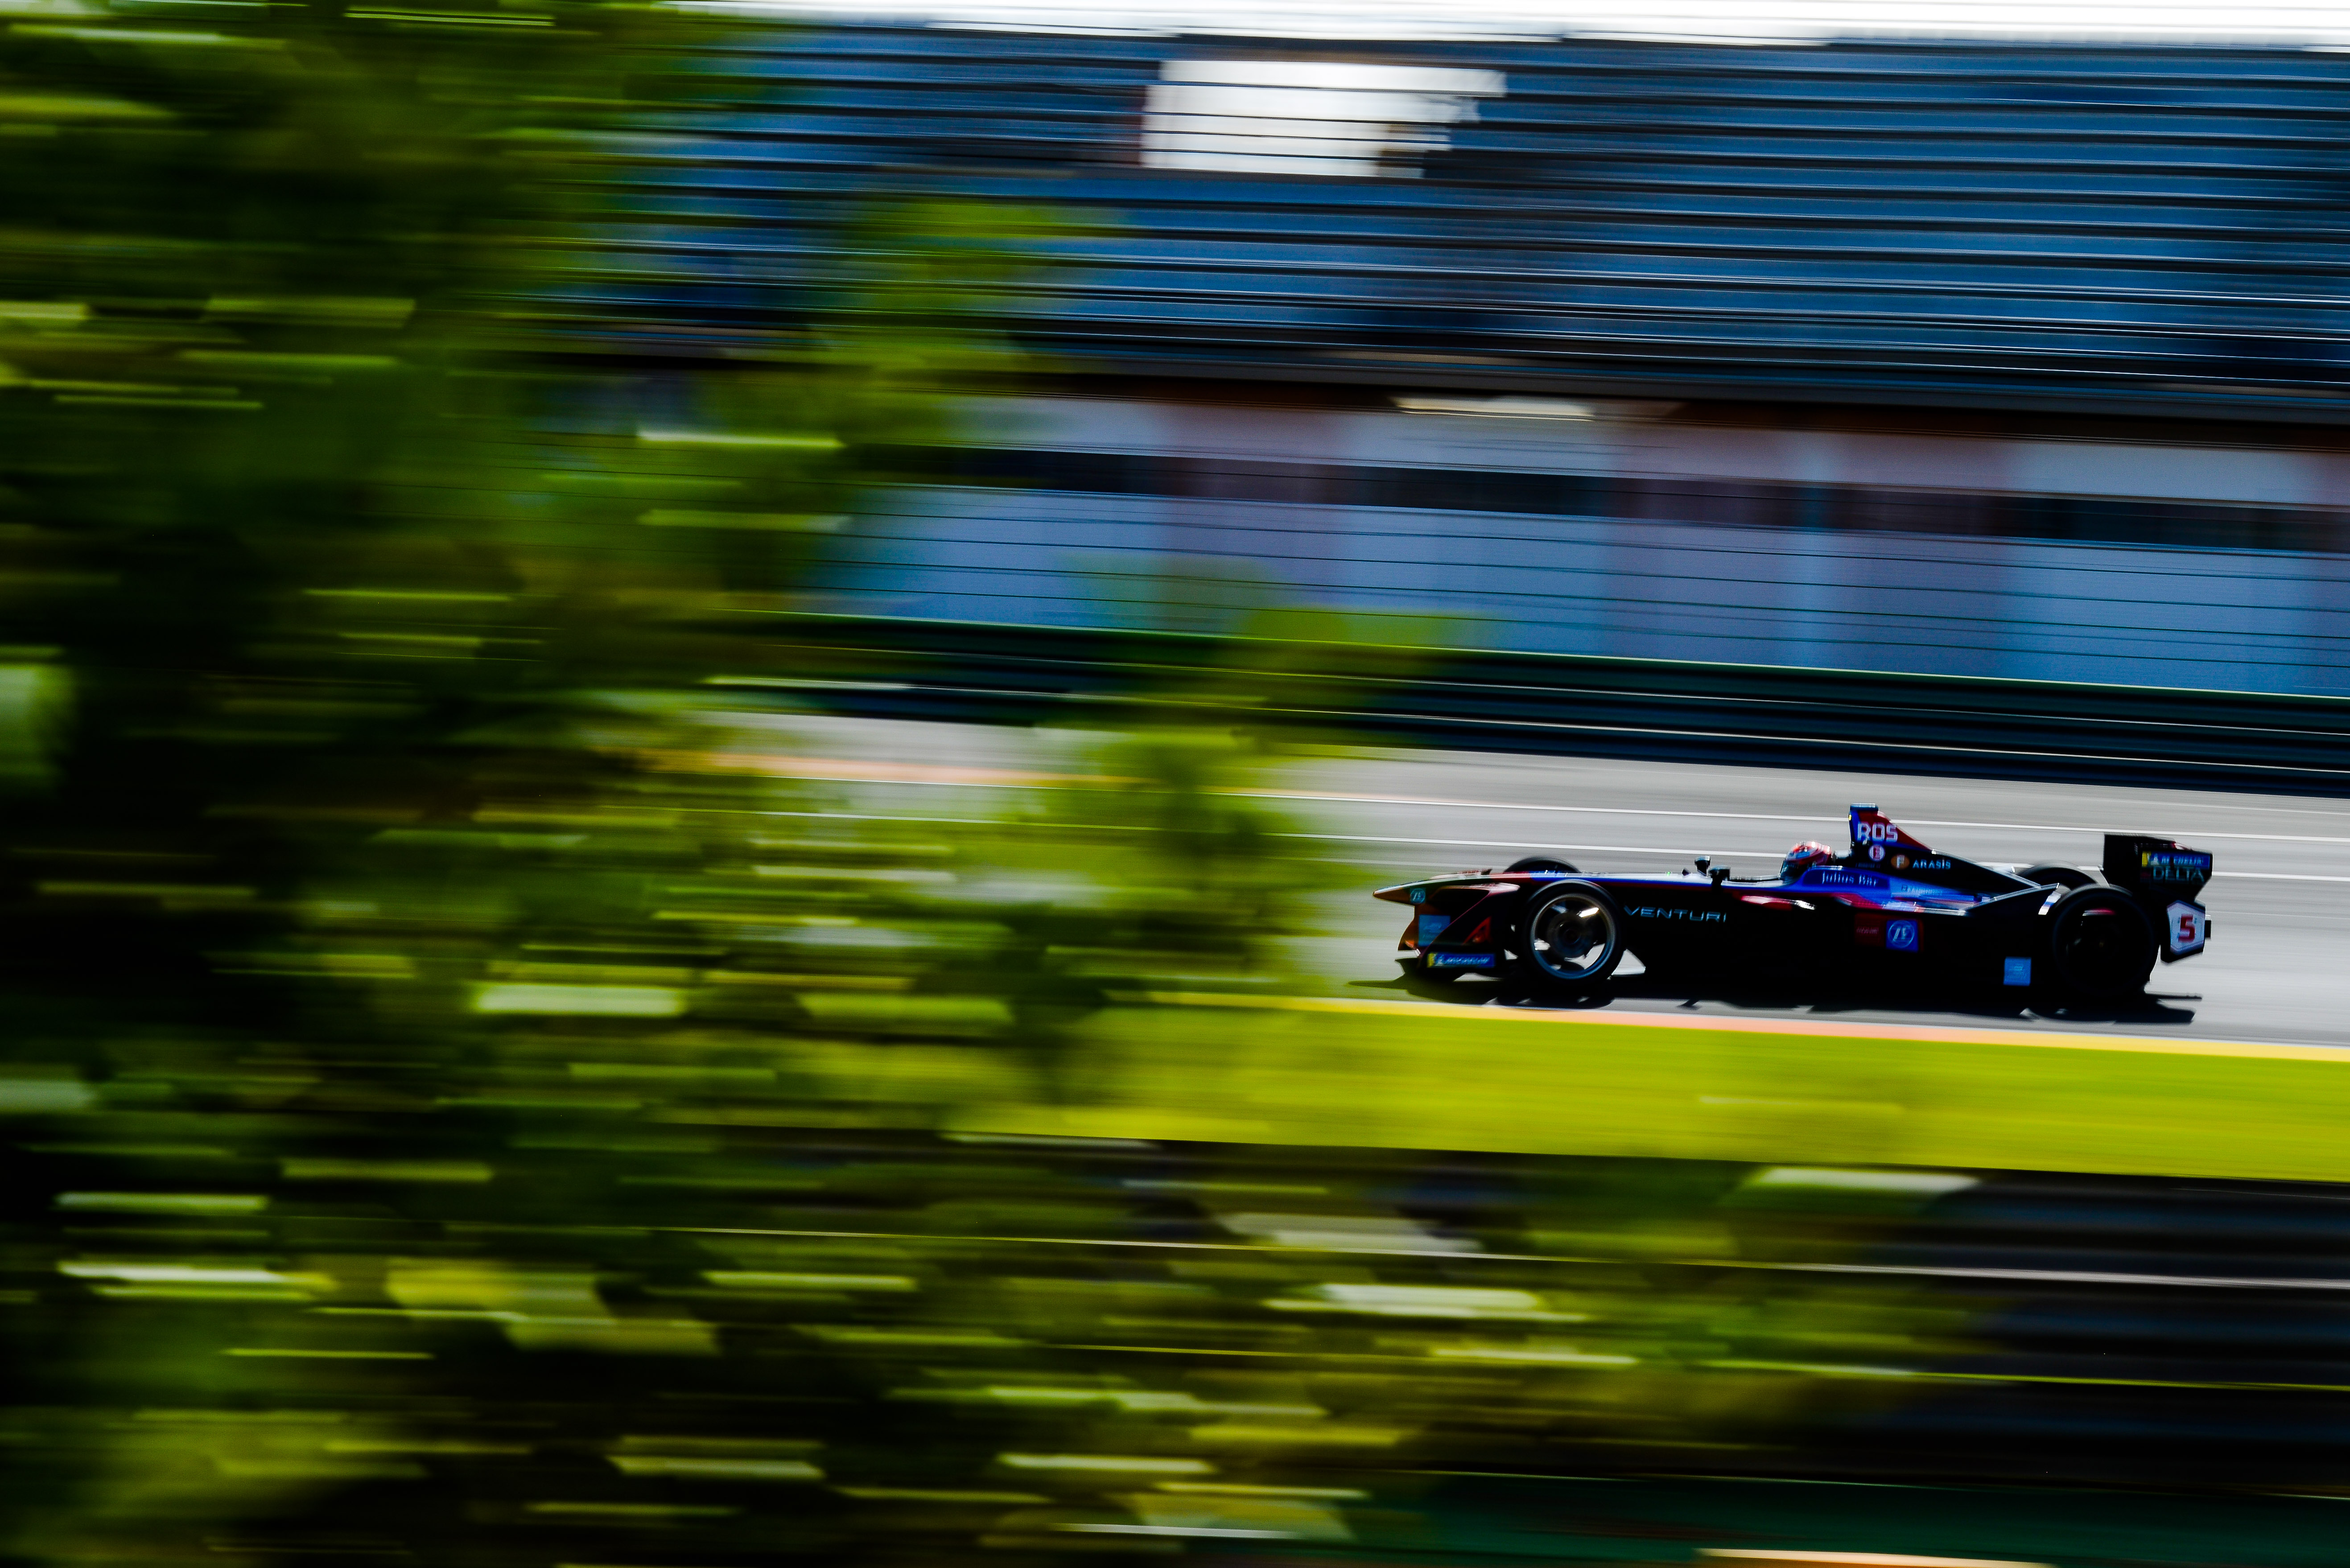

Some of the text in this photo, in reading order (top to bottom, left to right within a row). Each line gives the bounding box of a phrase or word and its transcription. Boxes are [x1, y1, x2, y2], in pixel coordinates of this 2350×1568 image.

[1857, 822, 1898, 842] ROS
[2161, 855, 2203, 865] MCHELIN
[1822, 871, 1854, 884] Julius
[2153, 866, 2205, 882] DELTA
[1623, 905, 1727, 923] VENTURI
[2178, 913, 2196, 943] 5
